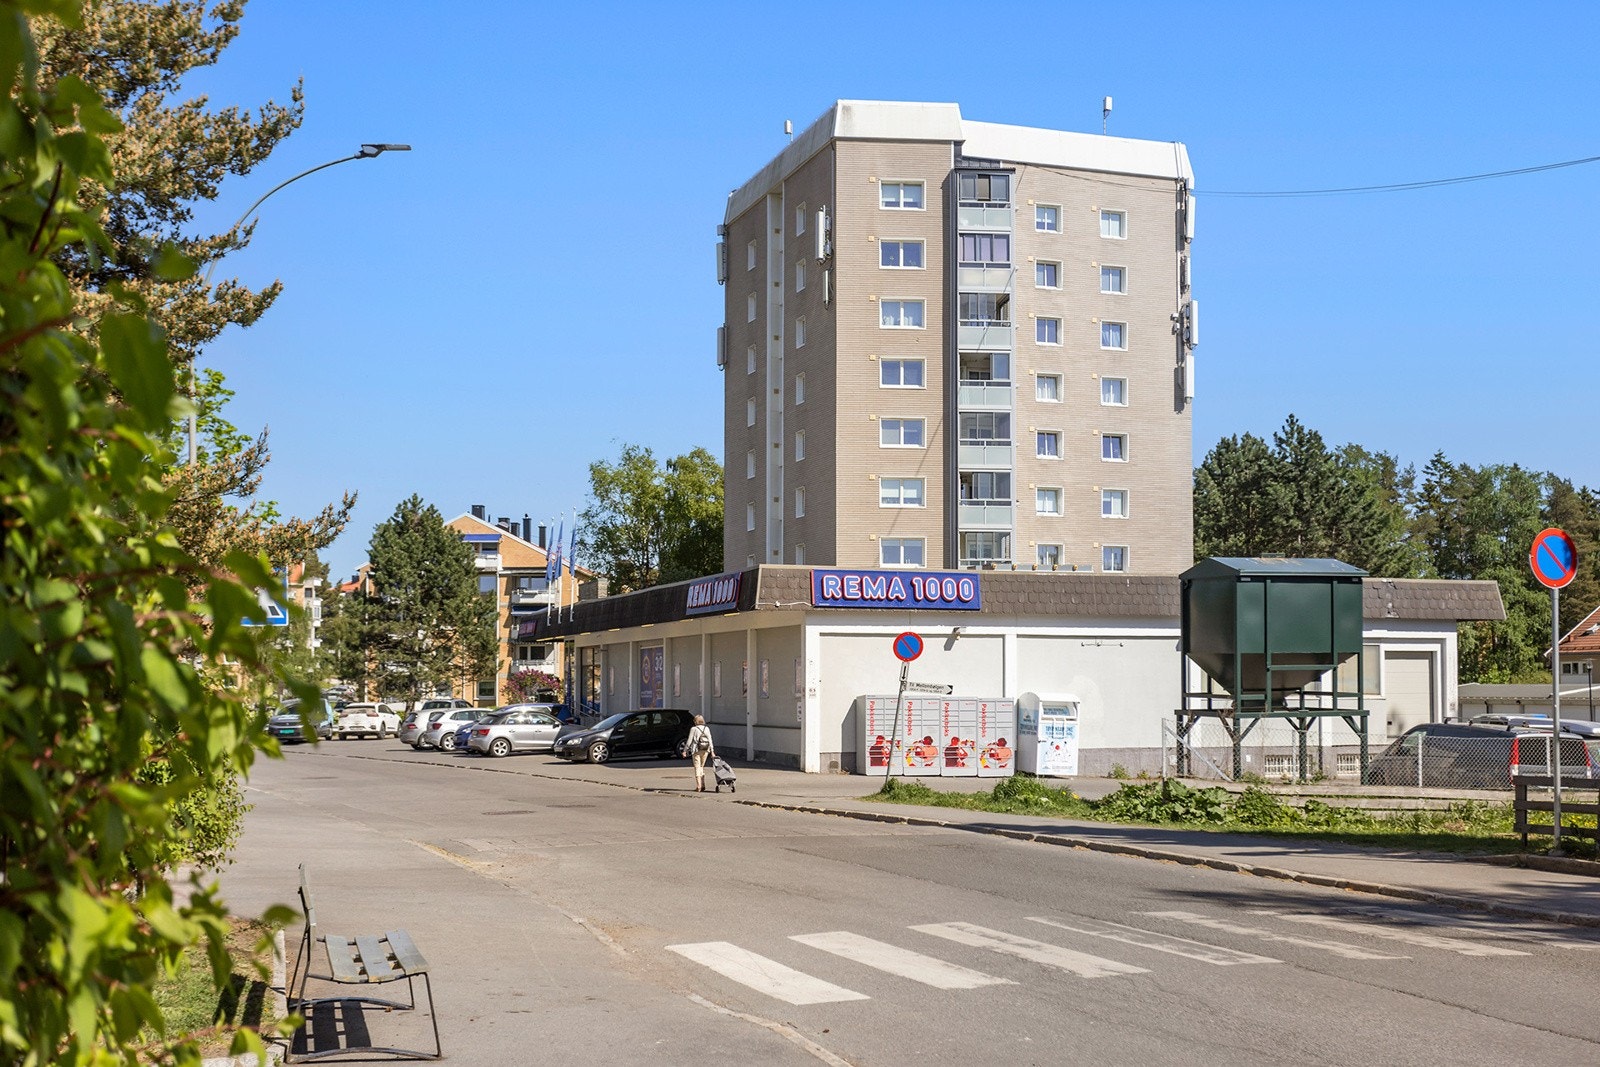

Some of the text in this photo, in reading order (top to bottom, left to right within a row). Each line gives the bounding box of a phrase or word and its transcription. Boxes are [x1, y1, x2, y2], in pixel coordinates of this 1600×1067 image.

[686, 578, 737, 608] REMA 1000
[822, 575, 975, 602] REMA 1000
